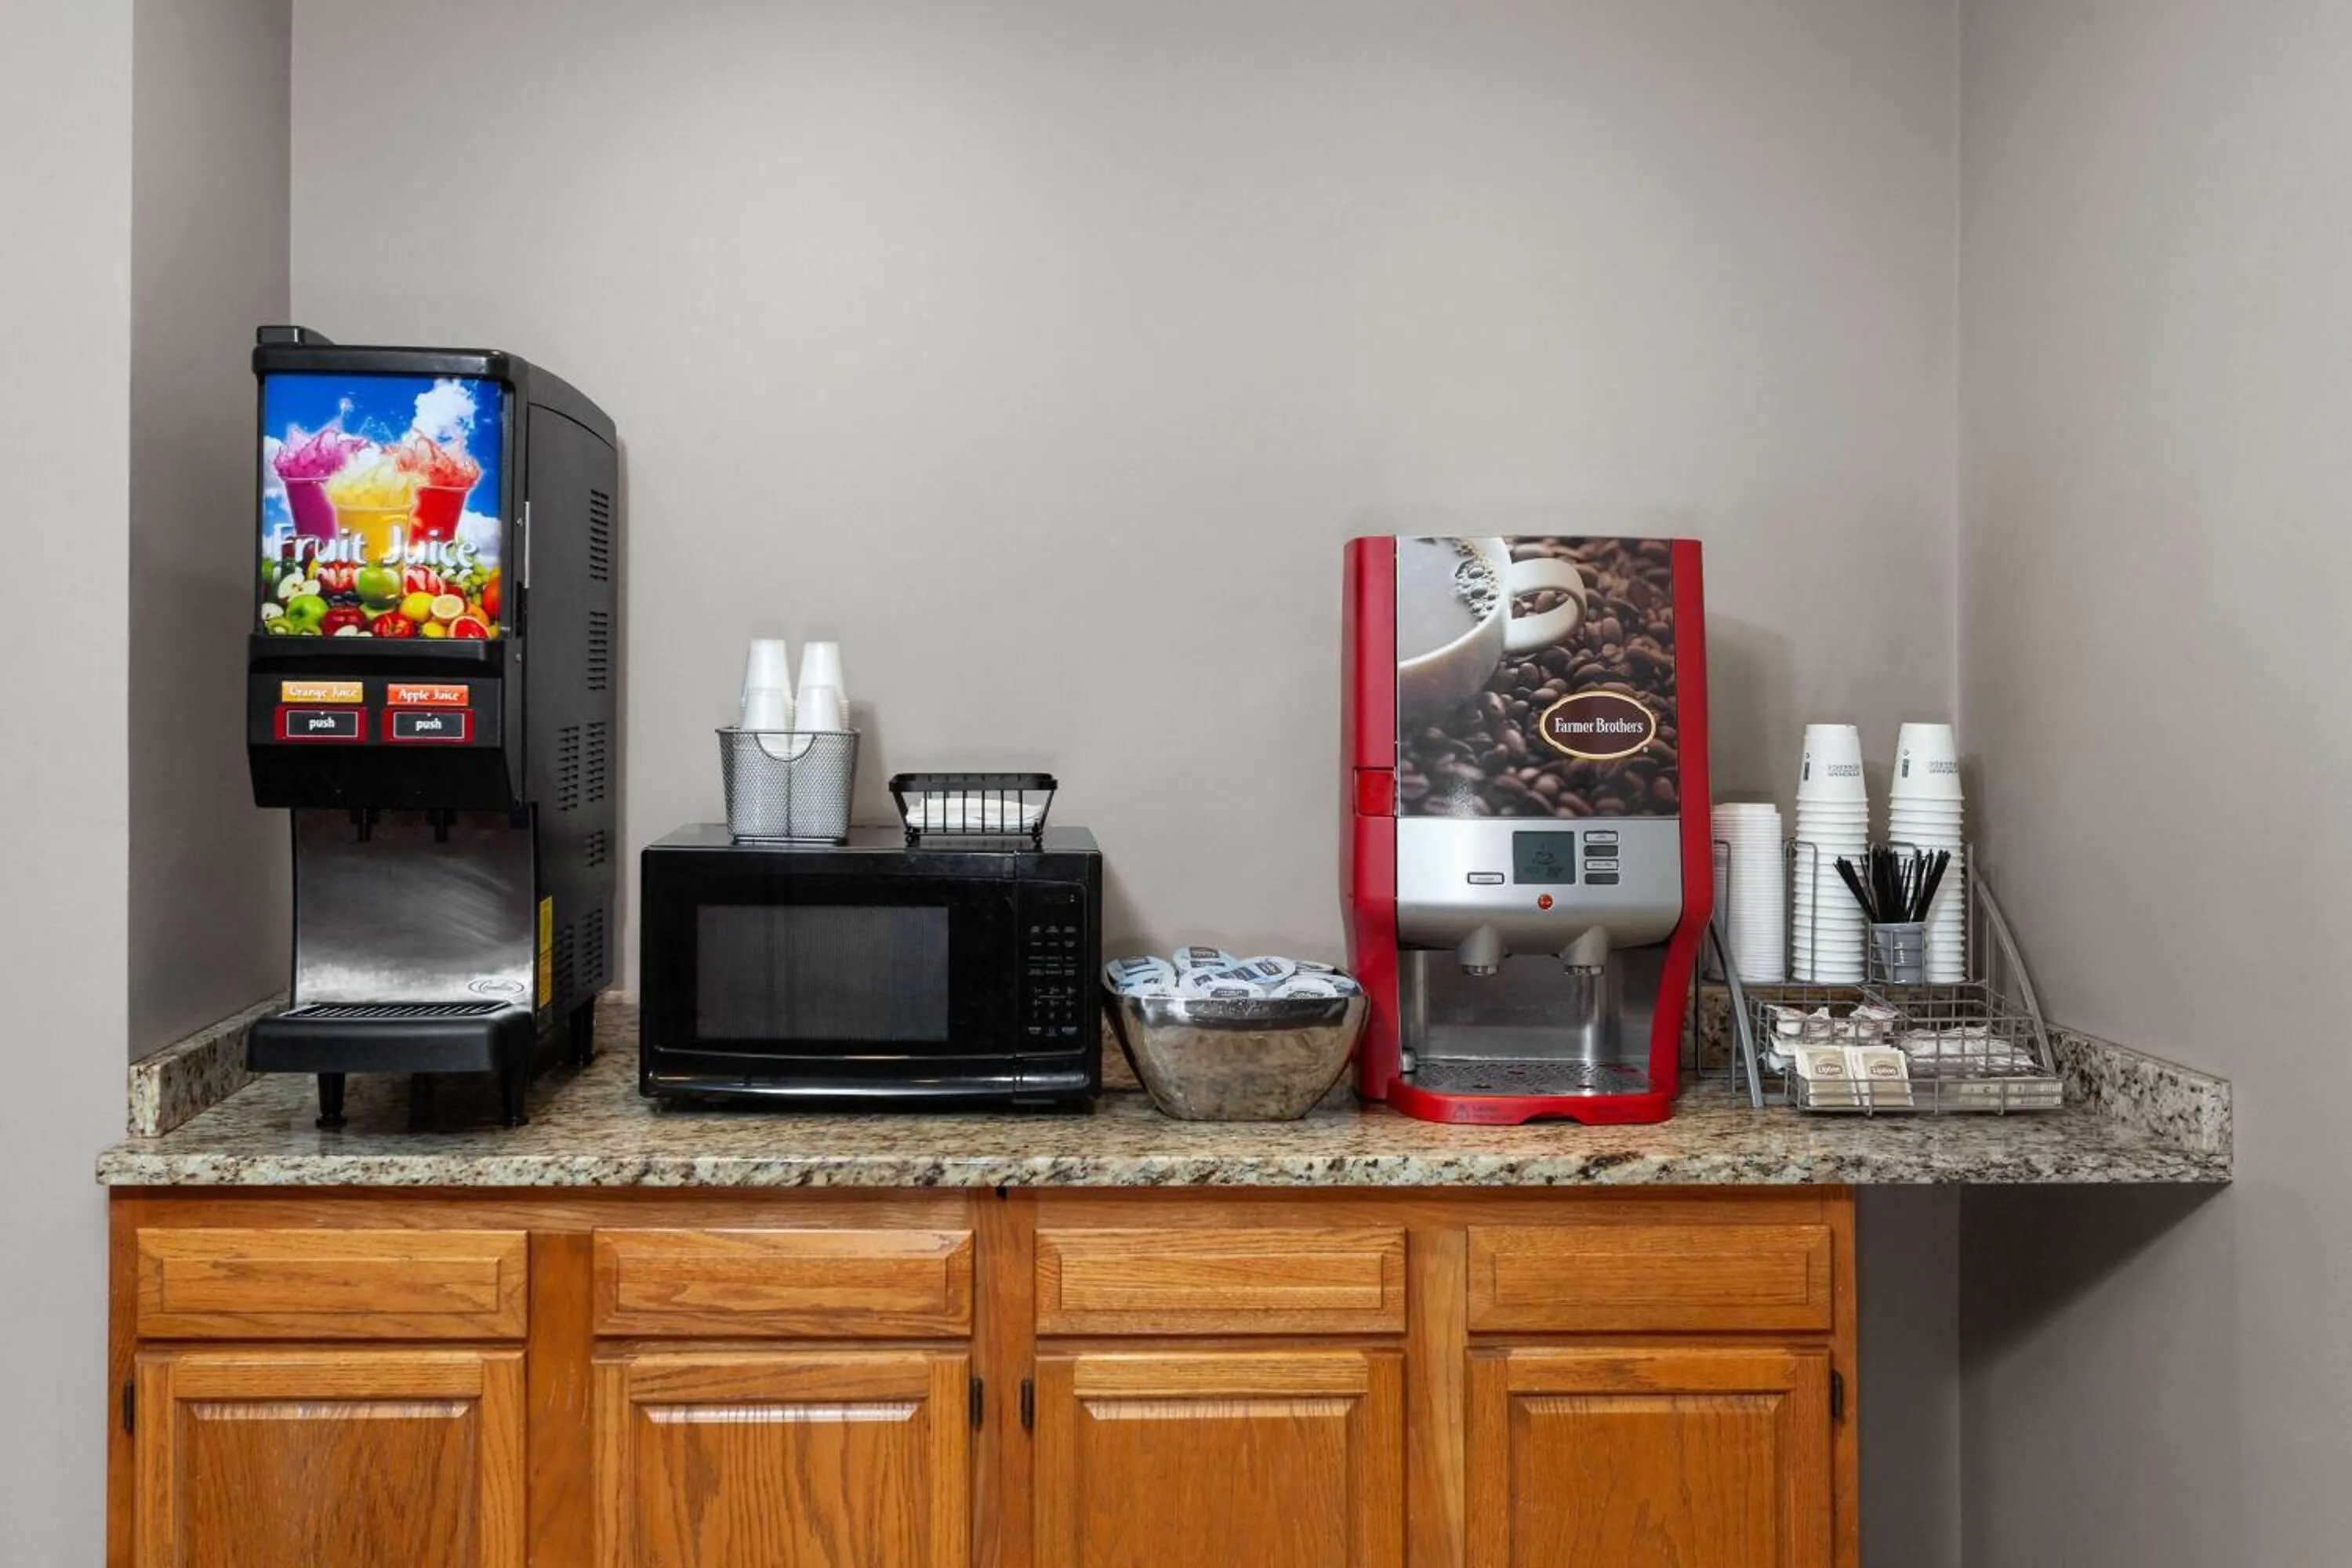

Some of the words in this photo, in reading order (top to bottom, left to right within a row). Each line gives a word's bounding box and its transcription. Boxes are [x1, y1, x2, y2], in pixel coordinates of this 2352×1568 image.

[273, 522, 366, 564] Fruit
[382, 524, 477, 568] Juice
[288, 686, 328, 700] Orange
[332, 686, 358, 698] Juice
[398, 688, 430, 702] Apple
[434, 688, 459, 700] Juice
[308, 717, 336, 731] push
[416, 717, 442, 731] push
[1554, 717, 1594, 733] Farmer
[1595, 717, 1644, 733] Brothers
